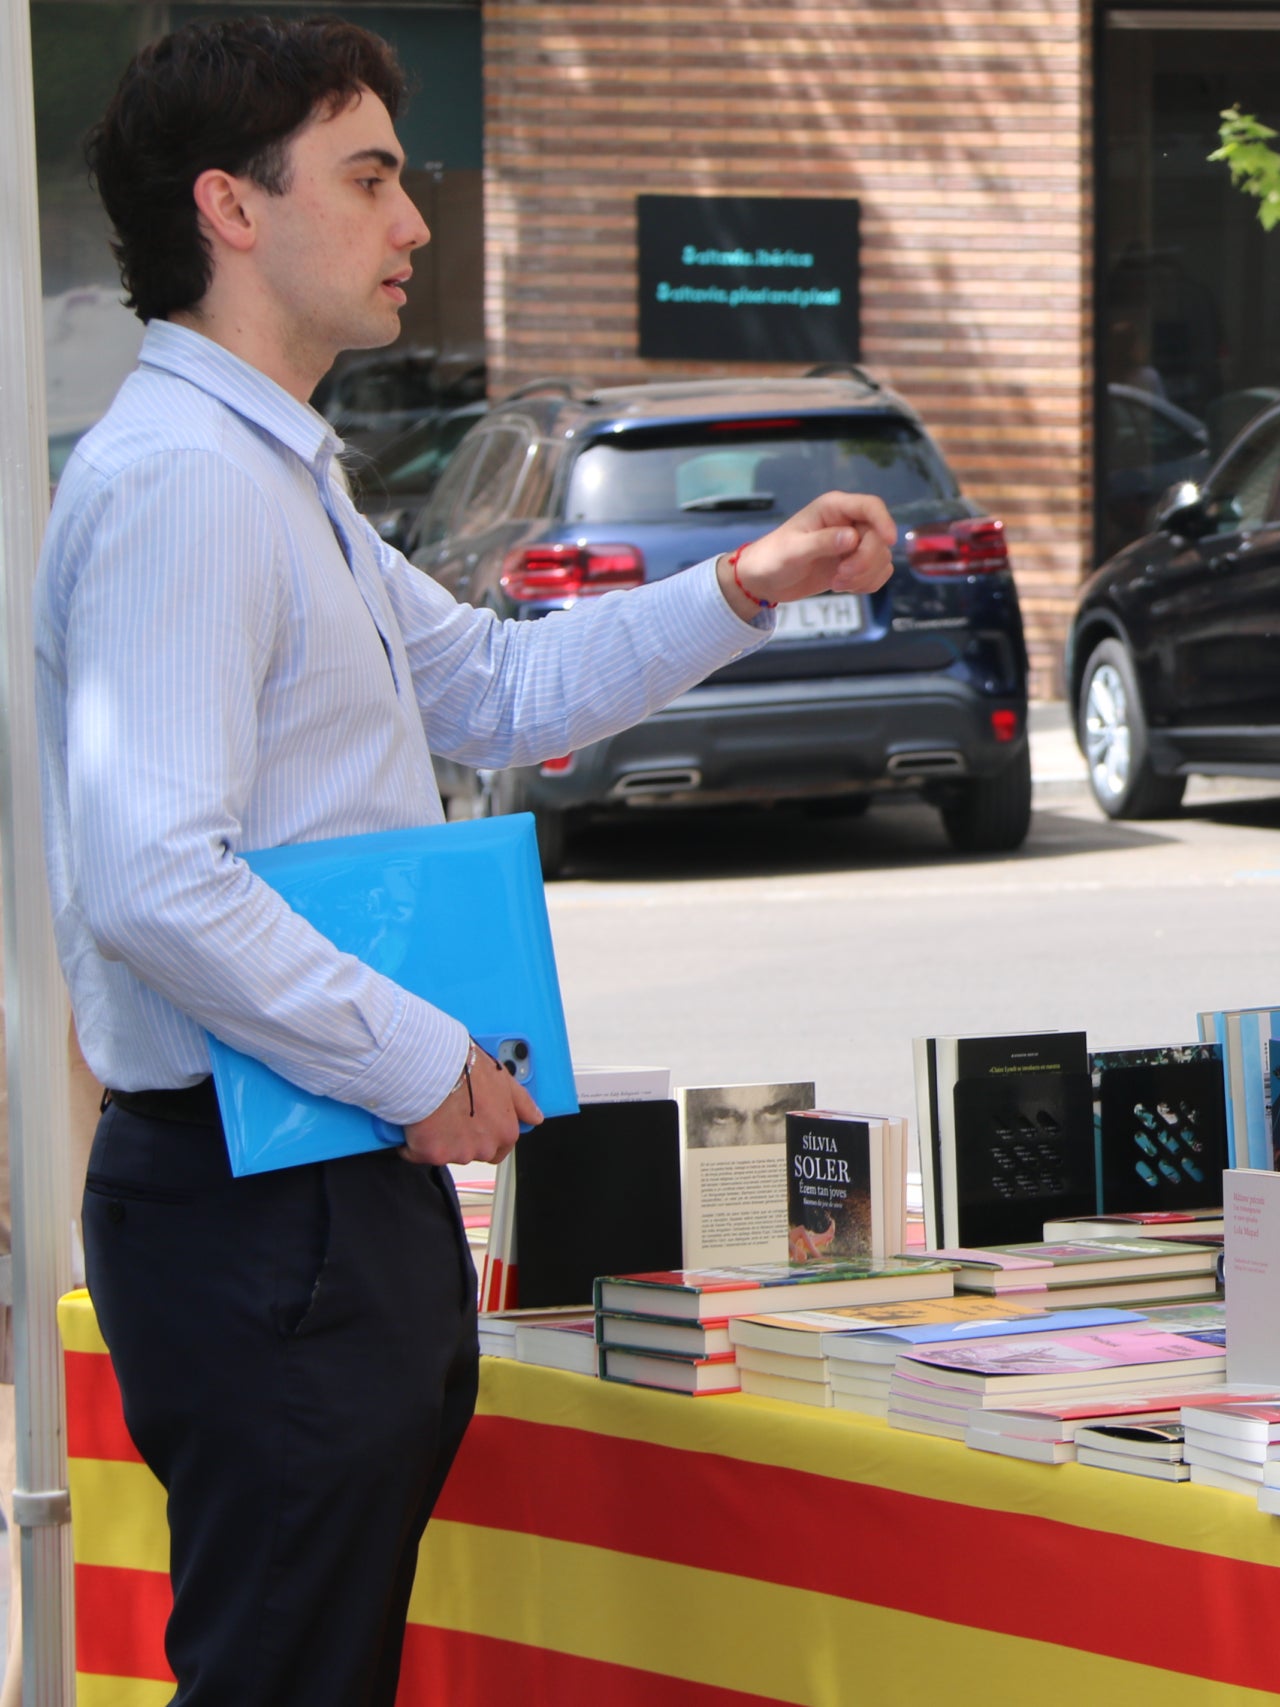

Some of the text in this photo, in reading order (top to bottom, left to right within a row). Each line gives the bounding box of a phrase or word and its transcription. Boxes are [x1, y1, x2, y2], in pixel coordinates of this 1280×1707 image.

[799, 603, 853, 627] LYH
[802, 1131, 838, 1153] SÍLVIA
[794, 1154, 852, 1183] SOLER
[817, 1185, 829, 1197] tan
[829, 1185, 847, 1200] joves
